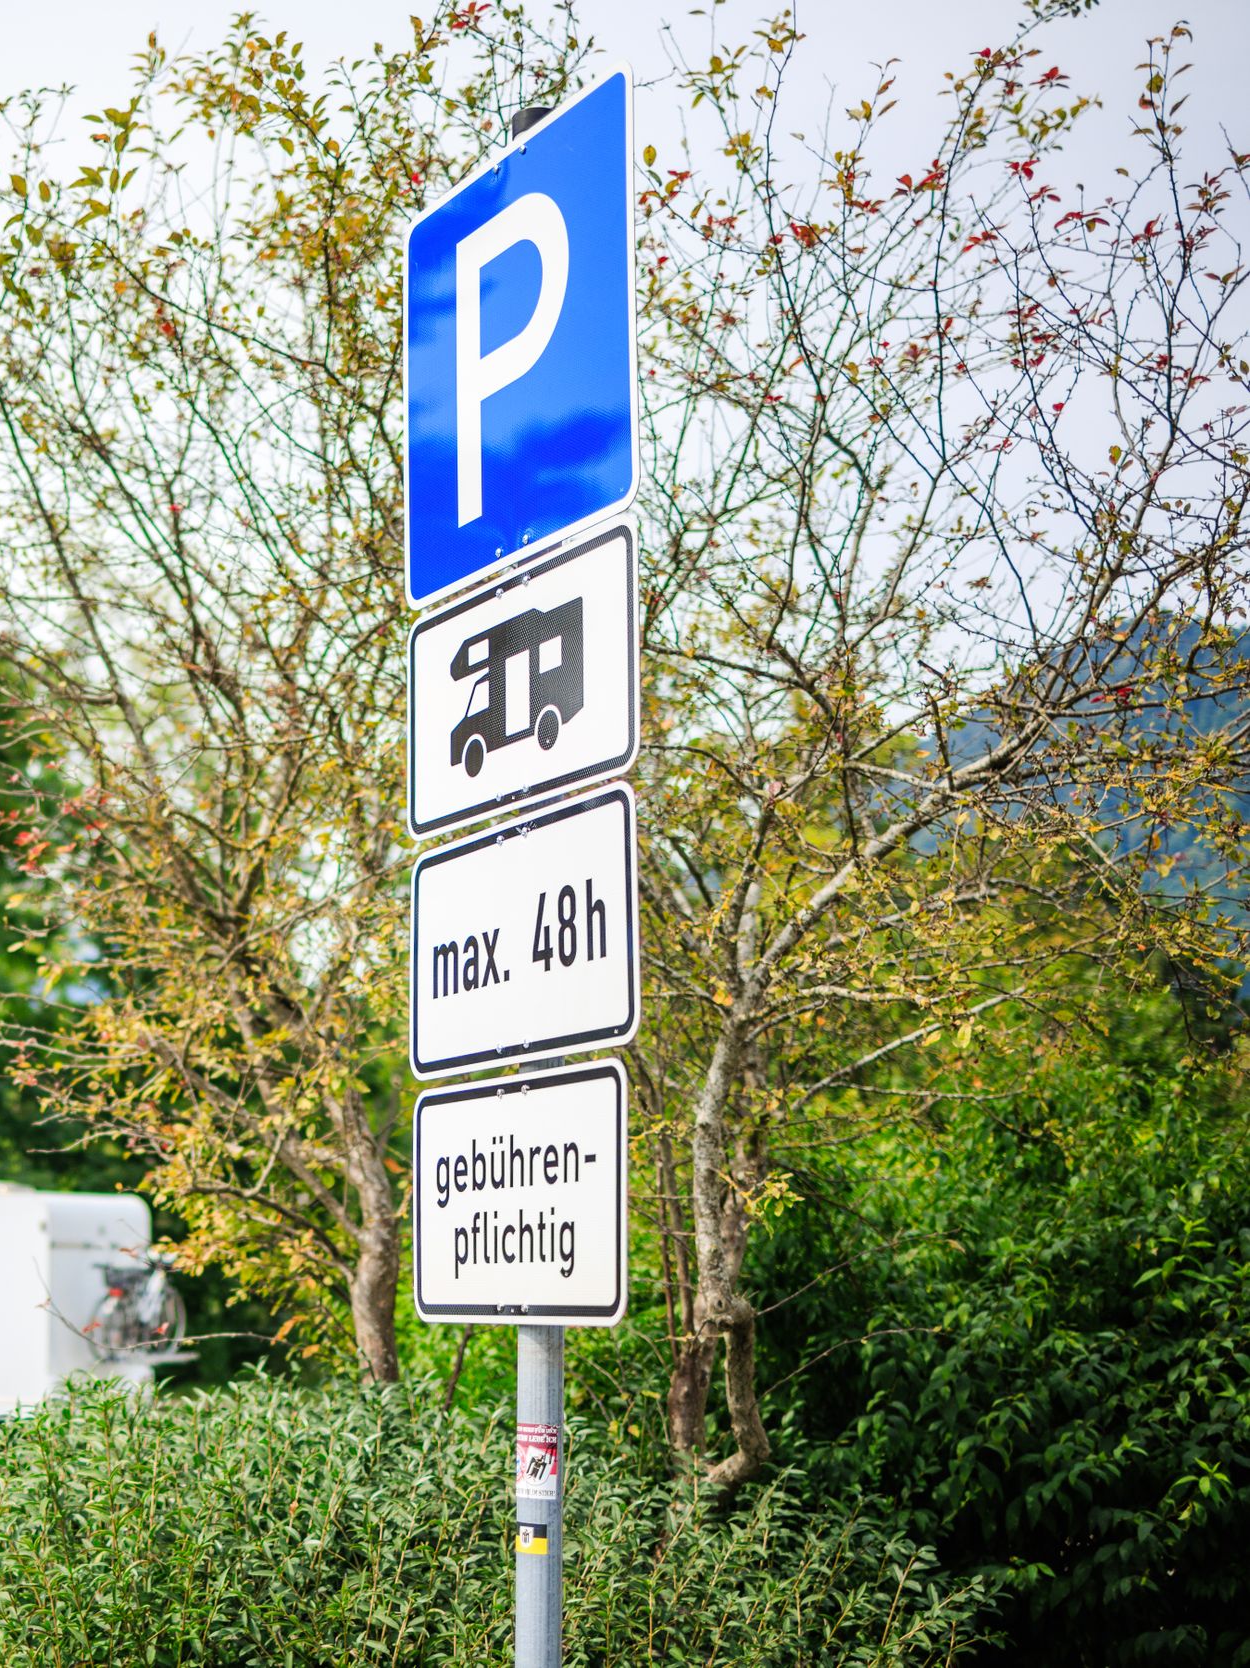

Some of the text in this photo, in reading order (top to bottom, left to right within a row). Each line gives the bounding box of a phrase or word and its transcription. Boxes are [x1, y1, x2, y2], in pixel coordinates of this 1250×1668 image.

[456, 192, 570, 529] P
[432, 877, 608, 1000] max. 48h
[435, 1133, 597, 1209] gebühren-
[454, 1206, 576, 1280] pflichtig
